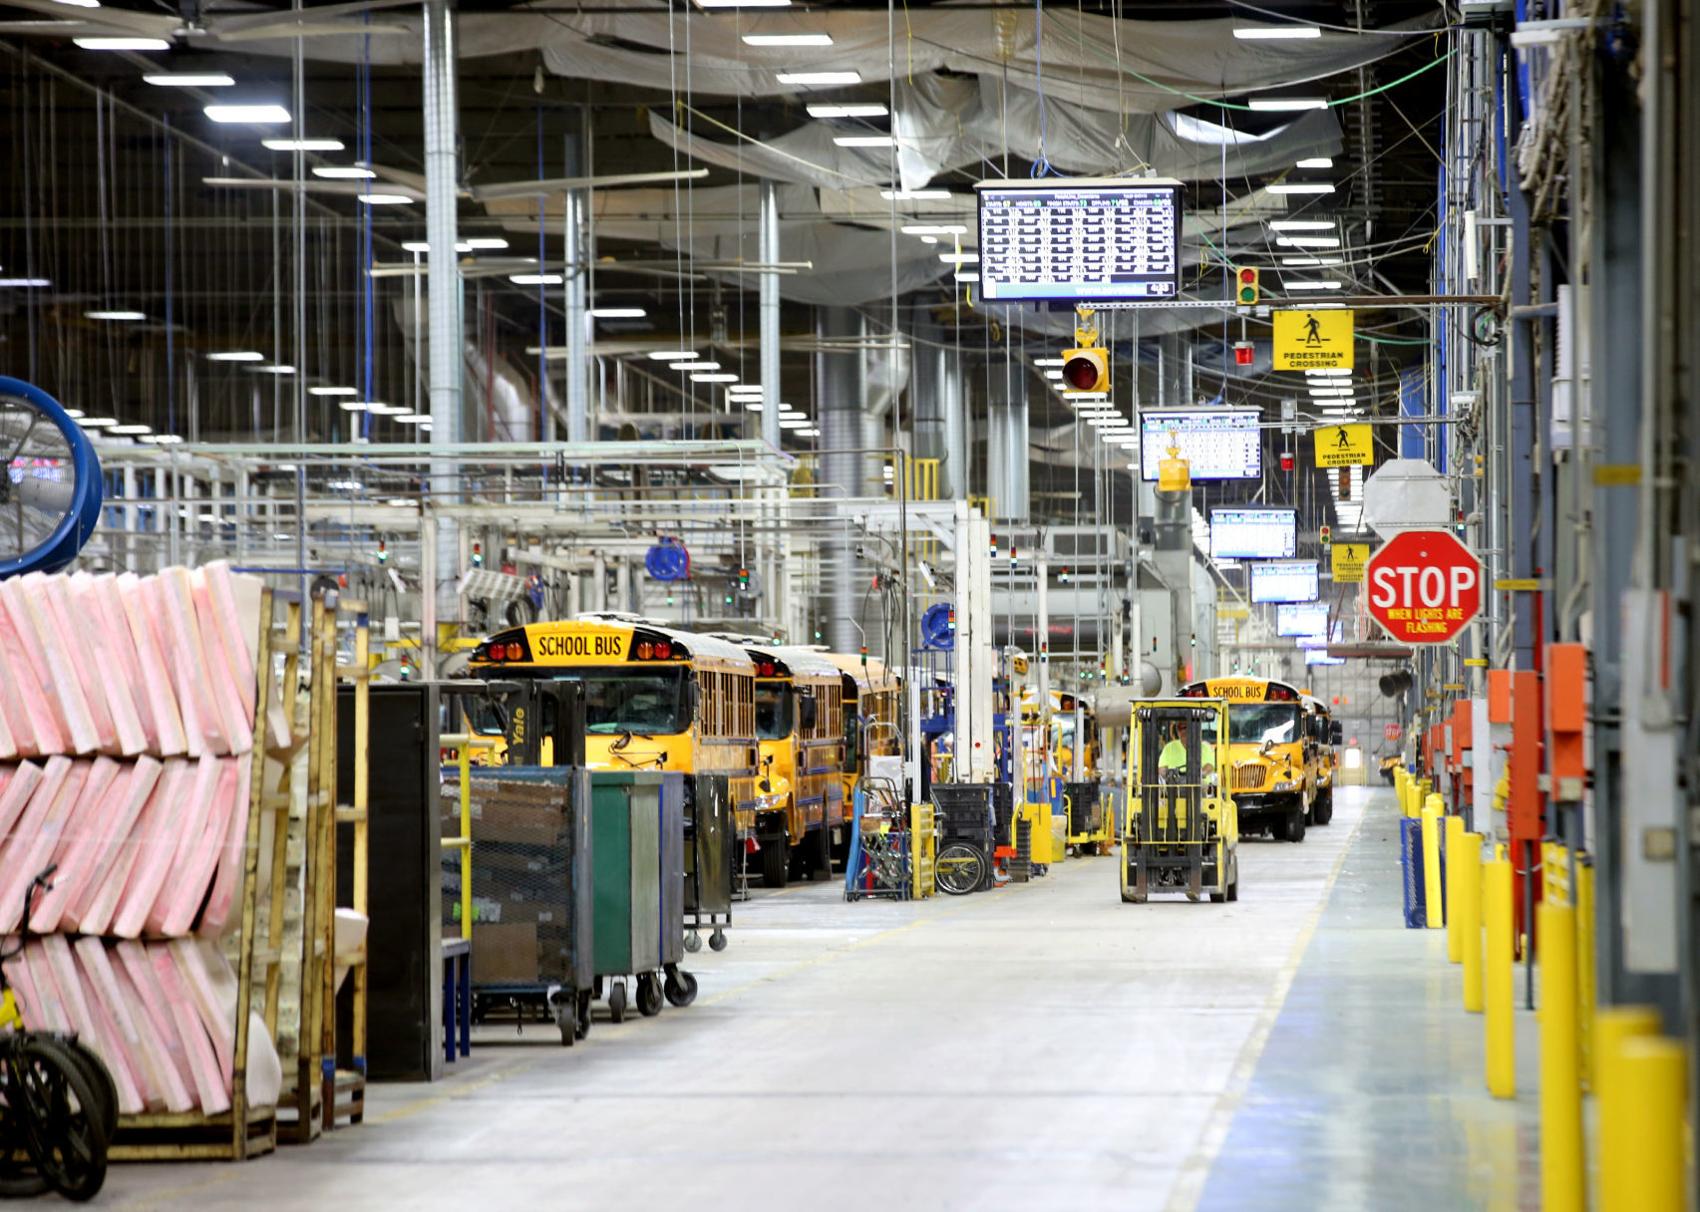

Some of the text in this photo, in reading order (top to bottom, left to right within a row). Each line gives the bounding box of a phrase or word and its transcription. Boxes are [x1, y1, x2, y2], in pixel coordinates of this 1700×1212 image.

[1283, 352, 1344, 360] PEDESTRIAN
[1289, 360, 1338, 368] CROSSING
[1372, 566, 1476, 608] STOP
[1387, 608, 1464, 620] WHEN LIGHTS ARE
[1405, 621, 1448, 634] FLASHING
[538, 636, 622, 656] SCHOOL BUS
[1213, 686, 1262, 698] SCHOOL BUS
[512, 707, 525, 746] Yale
